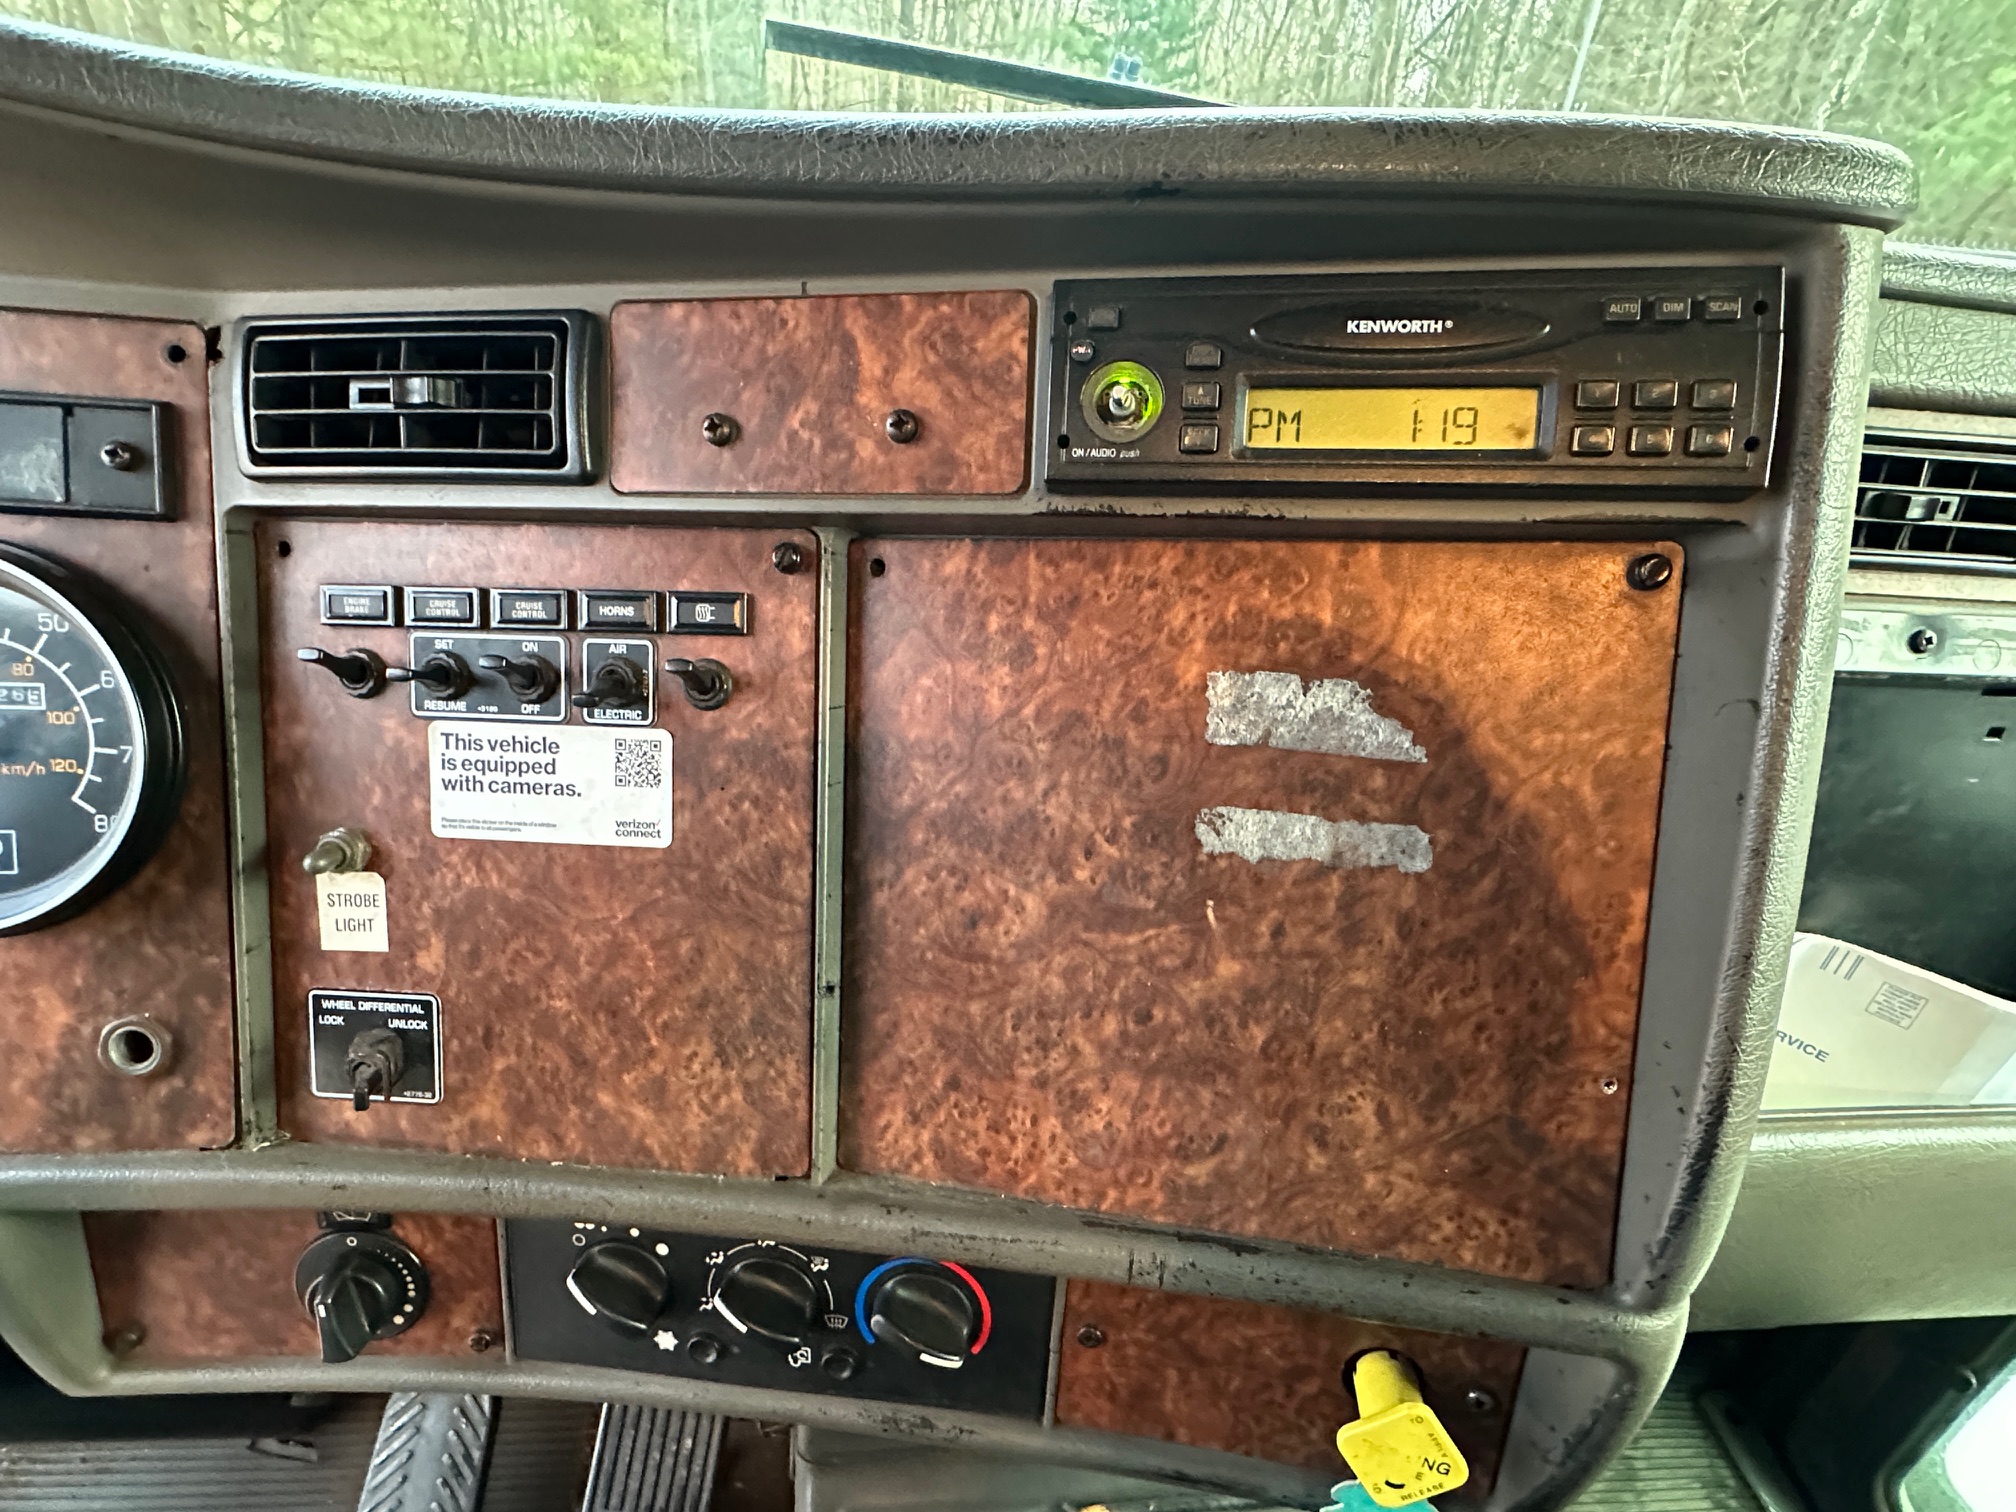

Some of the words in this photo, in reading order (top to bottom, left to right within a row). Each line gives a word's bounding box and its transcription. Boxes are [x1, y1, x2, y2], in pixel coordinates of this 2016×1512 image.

[1609, 303, 1638, 314] AUTO
[1662, 302, 1684, 313] DIM
[1707, 301, 1739, 312] SCAN
[1248, 407, 1302, 443] PM
[1412, 406, 1479, 446] 1:19
[1119, 449, 1140, 459] push
[429, 599, 457, 609] CRUISE
[515, 601, 543, 611] CRUISE
[425, 607, 461, 617] CONTROL
[511, 609, 548, 619] CONTROL
[599, 605, 635, 617] HORNS
[434, 638, 455, 650] SET
[521, 641, 539, 653] ON
[608, 643, 627, 655] AIR
[12, 662, 35, 677] 80
[424, 700, 468, 712] RESUME
[521, 703, 541, 715] OFF
[46, 710, 76, 725] 100
[594, 708, 643, 720] ELECTRIC
[440, 732, 484, 751] This
[487, 735, 560, 755] vehicle
[0, 760, 46, 777] km/h
[49, 757, 78, 773] 120
[441, 752, 457, 771] is
[461, 755, 556, 777] equipped
[441, 774, 484, 793] with
[488, 779, 582, 798] cameras.
[615, 819, 656, 830] verizon
[615, 829, 661, 839] connect
[327, 892, 380, 909] STROBE
[335, 917, 374, 933] LIGHT
[321, 998, 356, 1011] WHEEL
[358, 1001, 425, 1015] DIFFERENTIAL
[318, 1014, 345, 1026] LOCK
[388, 1018, 428, 1030] UNLOCK
